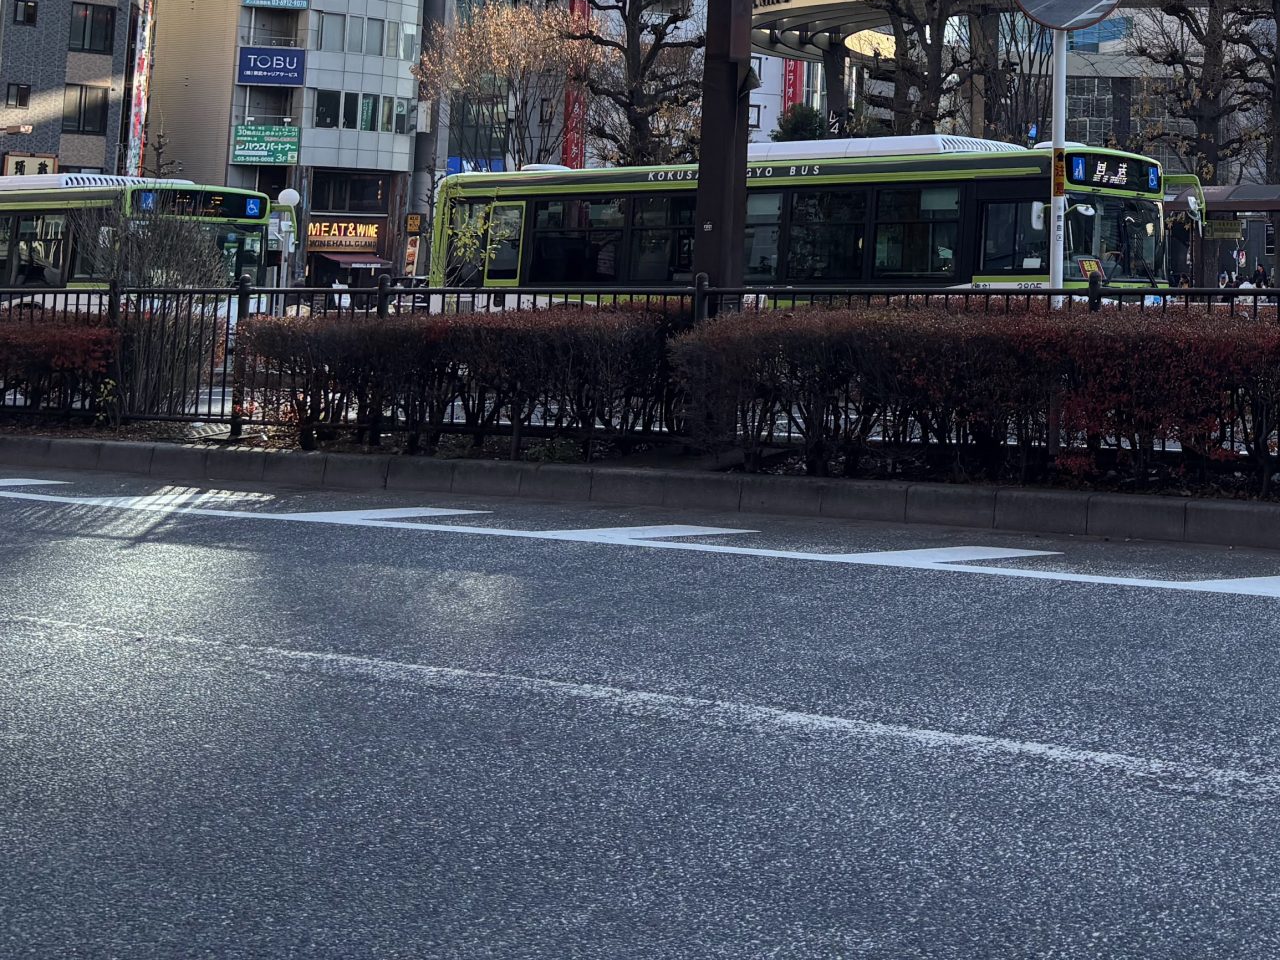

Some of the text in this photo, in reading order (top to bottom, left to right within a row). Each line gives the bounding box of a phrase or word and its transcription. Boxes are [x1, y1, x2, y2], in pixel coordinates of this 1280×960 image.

[247, 54, 297, 69] TOBU
[244, 142, 297, 151] ハウスパートナー
[647, 170, 699, 181] KOKUS
[789, 165, 820, 176] BUS
